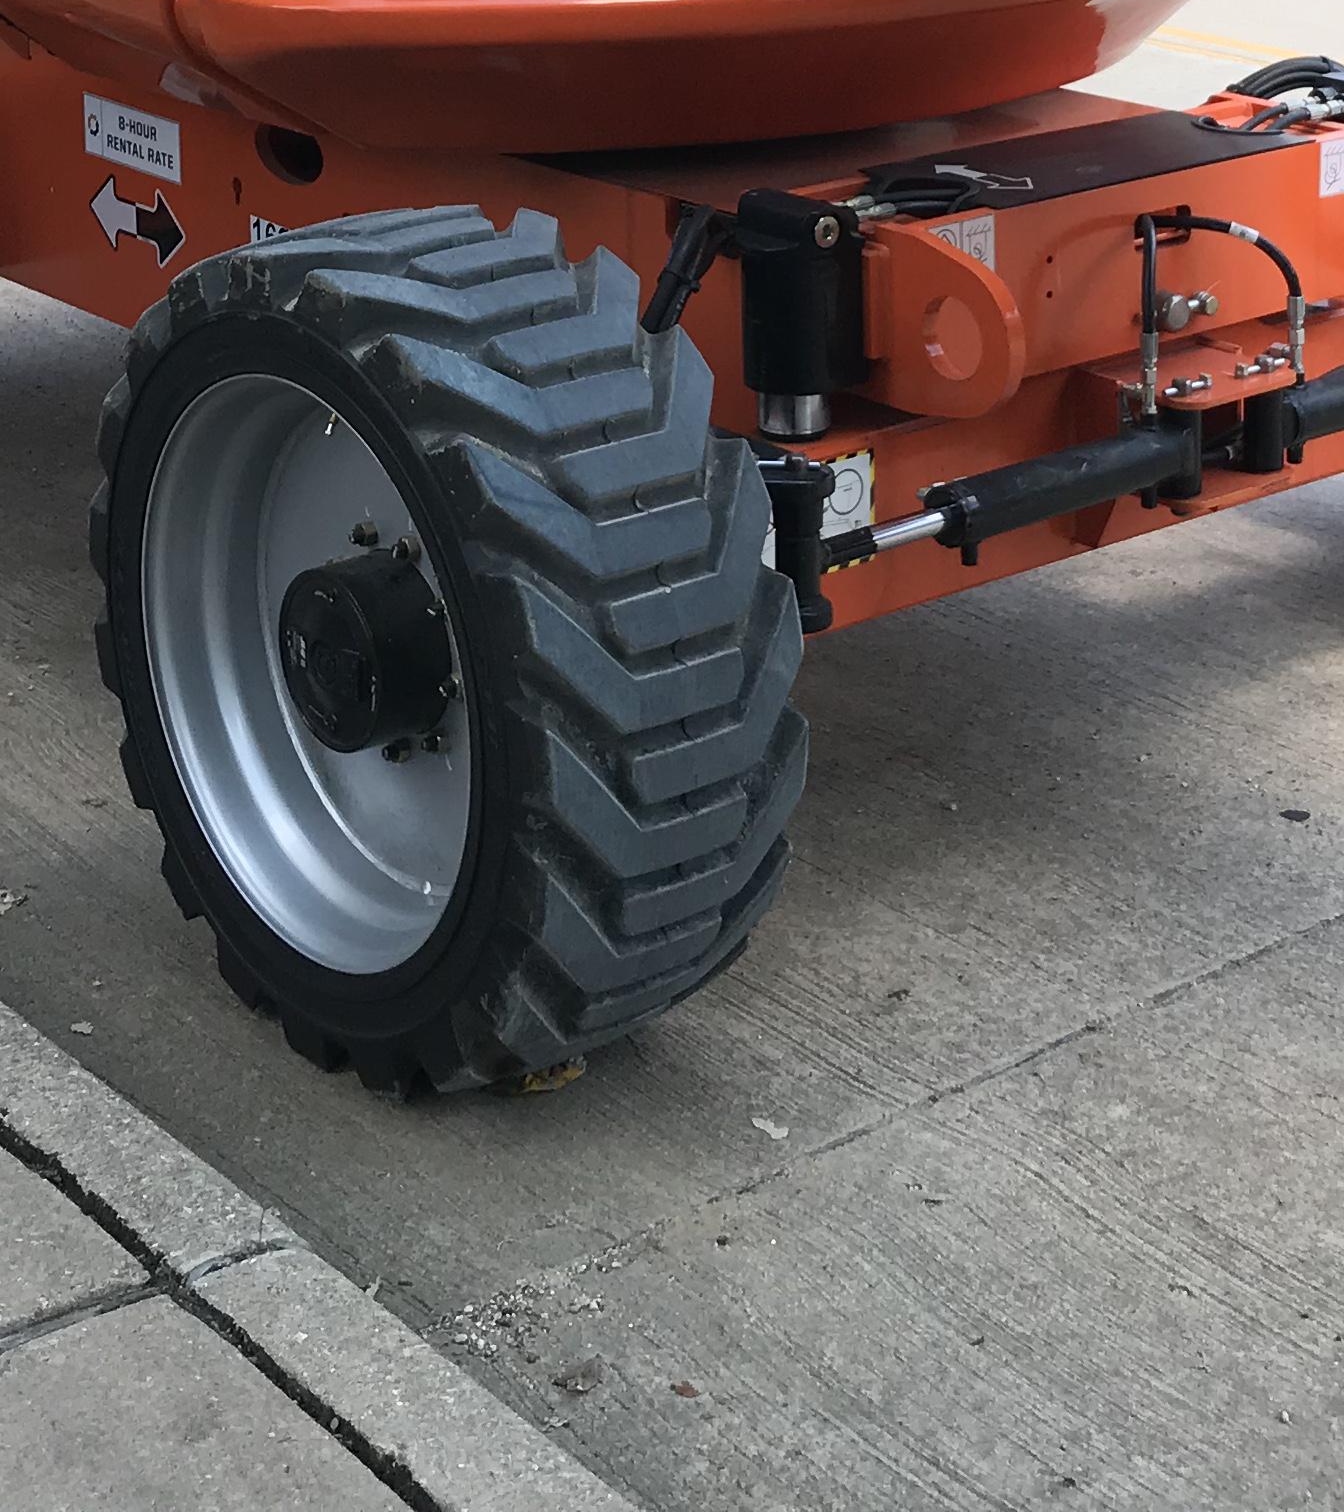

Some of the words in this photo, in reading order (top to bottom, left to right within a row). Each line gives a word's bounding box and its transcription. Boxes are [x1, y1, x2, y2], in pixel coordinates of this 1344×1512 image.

[118, 116, 157, 141] 8-HOUR
[106, 134, 145, 160] RENTAL
[147, 149, 174, 170] RATE
